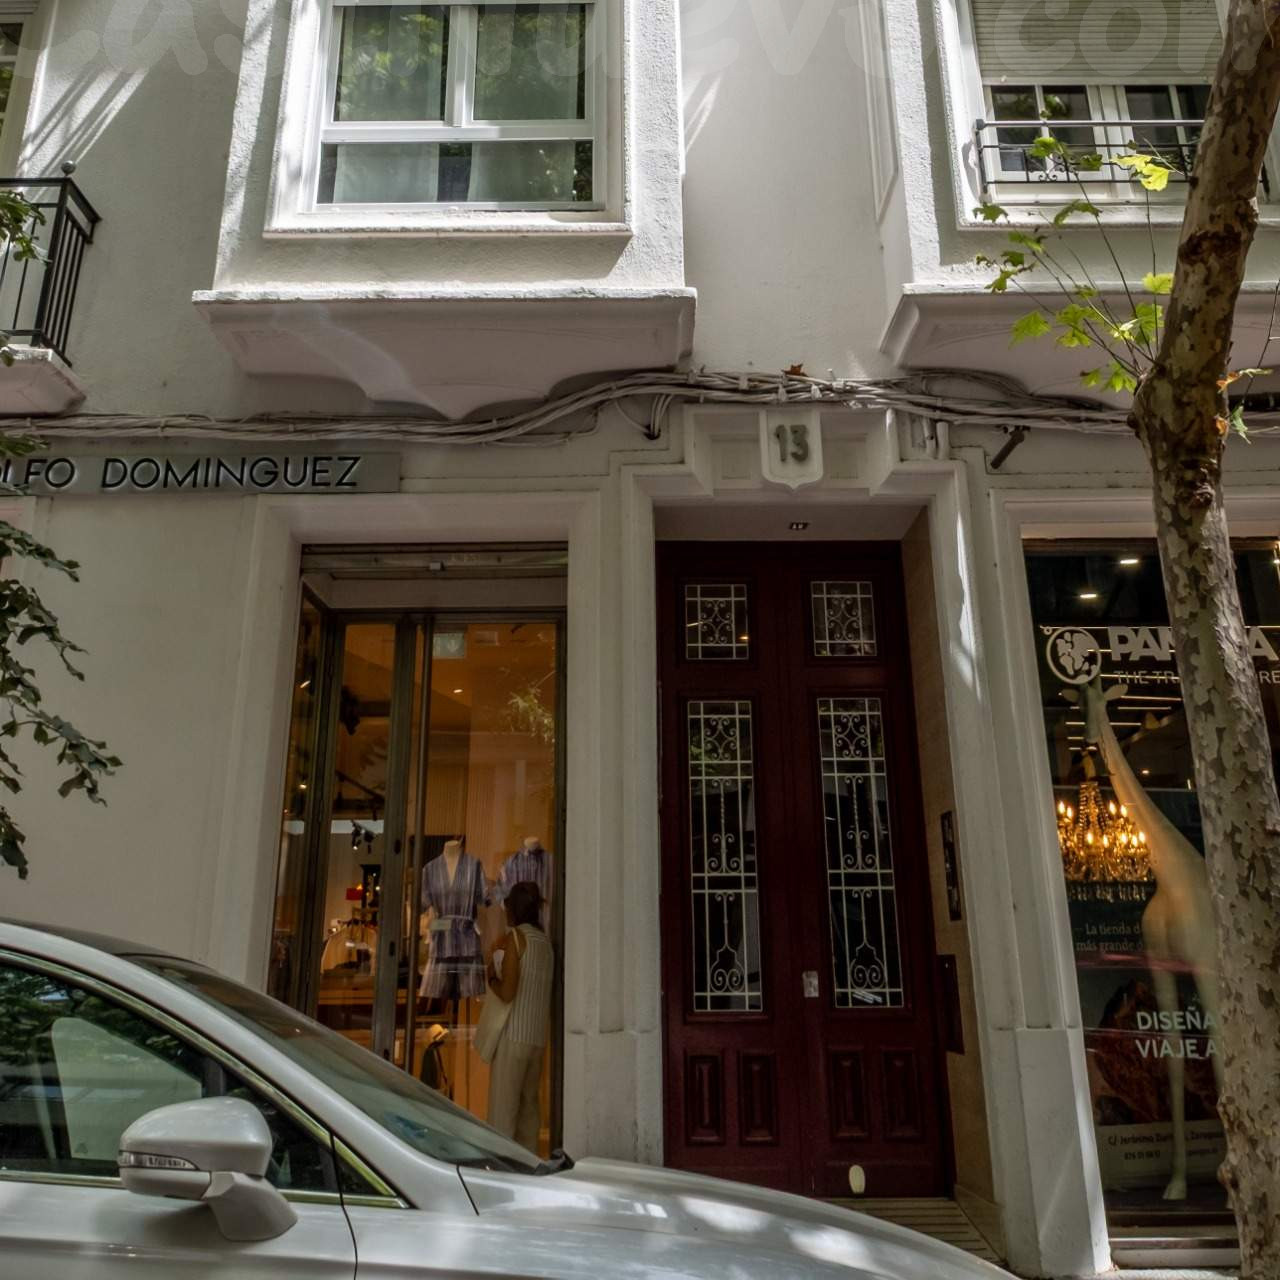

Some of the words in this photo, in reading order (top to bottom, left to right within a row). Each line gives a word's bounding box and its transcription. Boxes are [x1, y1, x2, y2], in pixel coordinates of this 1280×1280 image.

[775, 423, 809, 462] 13
[101, 457, 361, 489] DOMINGUEZ
[1113, 670, 1149, 685] THE
[1135, 1038, 1200, 1059] VIAJE
